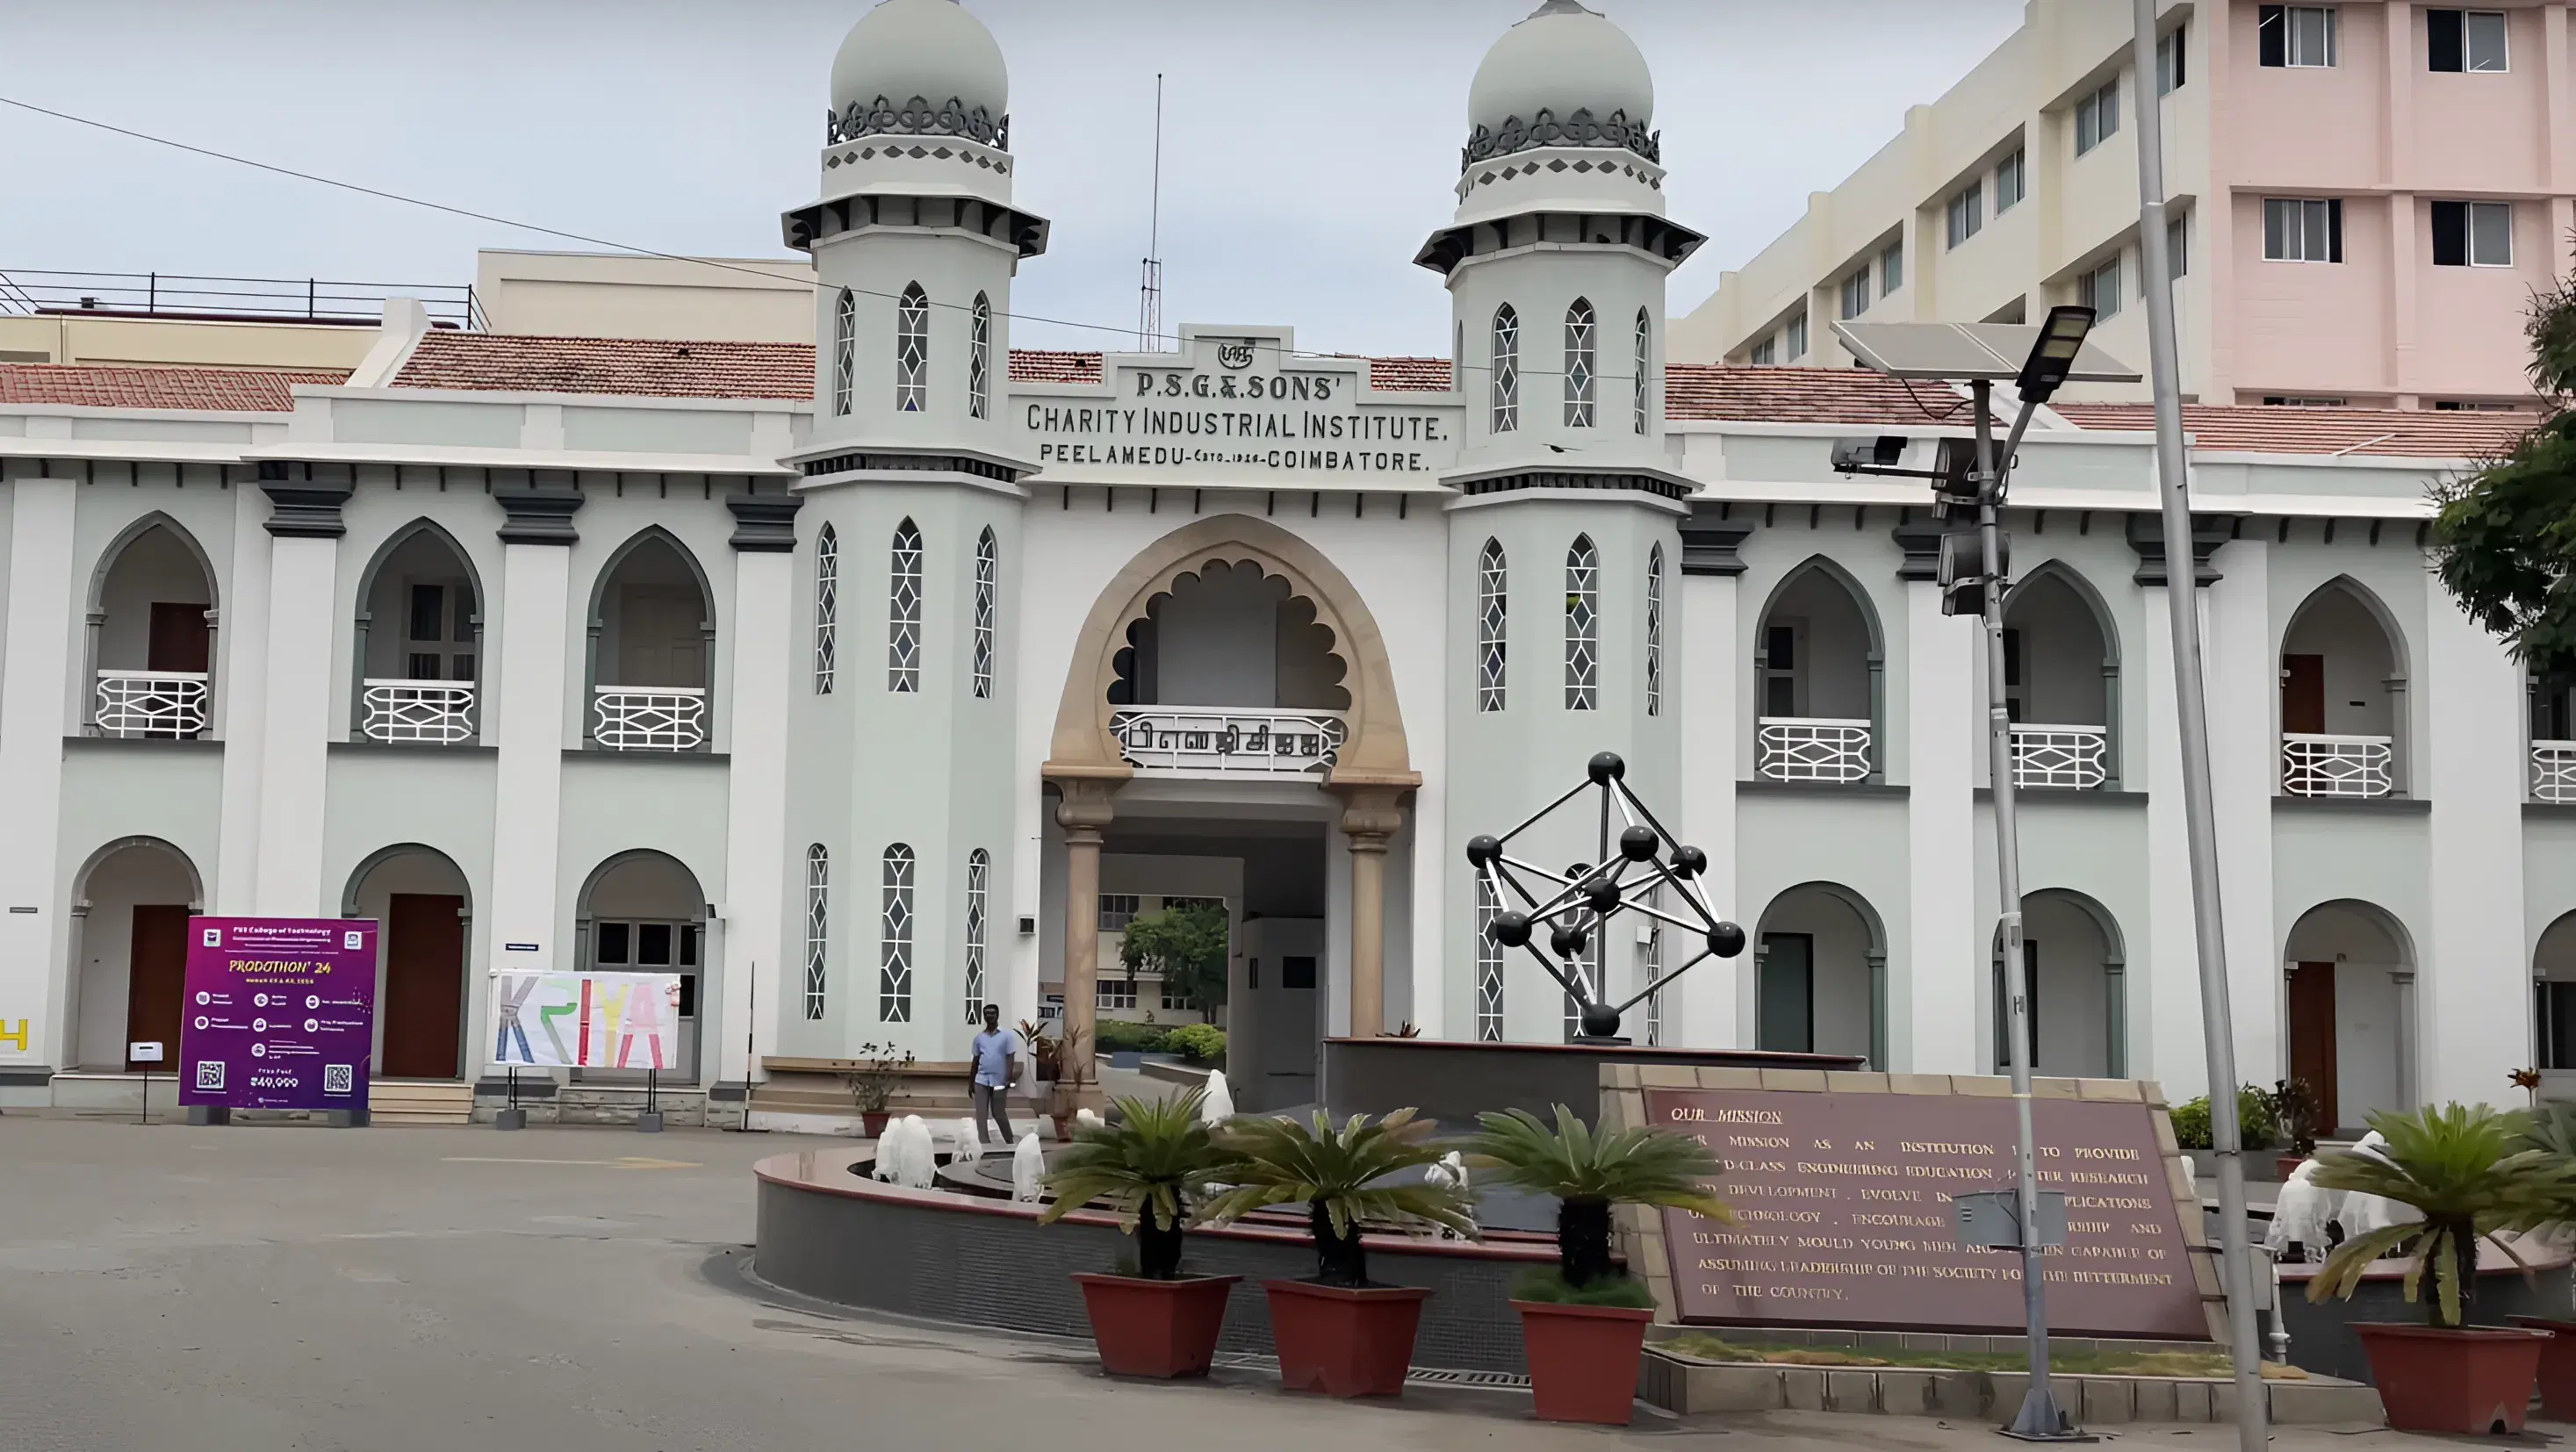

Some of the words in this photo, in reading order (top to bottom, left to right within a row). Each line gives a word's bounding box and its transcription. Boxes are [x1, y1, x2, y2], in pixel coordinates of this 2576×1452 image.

[1027, 404, 1136, 434] CHARITY
[1143, 407, 1296, 437] INDUSTRIAL
[1304, 411, 1448, 441] INSTITUTE.
[1671, 1108, 1705, 1121] OUR
[1718, 1110, 1783, 1124] MISSION
[1729, 1135, 1790, 1148] MISSION
[1814, 1139, 1831, 1149] AS
[1854, 1141, 1874, 1151] AN
[2039, 1147, 2061, 1157] TO
[2075, 1147, 2141, 1161] PROVIDE
[2131, 1224, 2162, 1234] AND
[1797, 1237, 1853, 1249] MOULD
[1861, 1239, 1916, 1252] YOUNG
